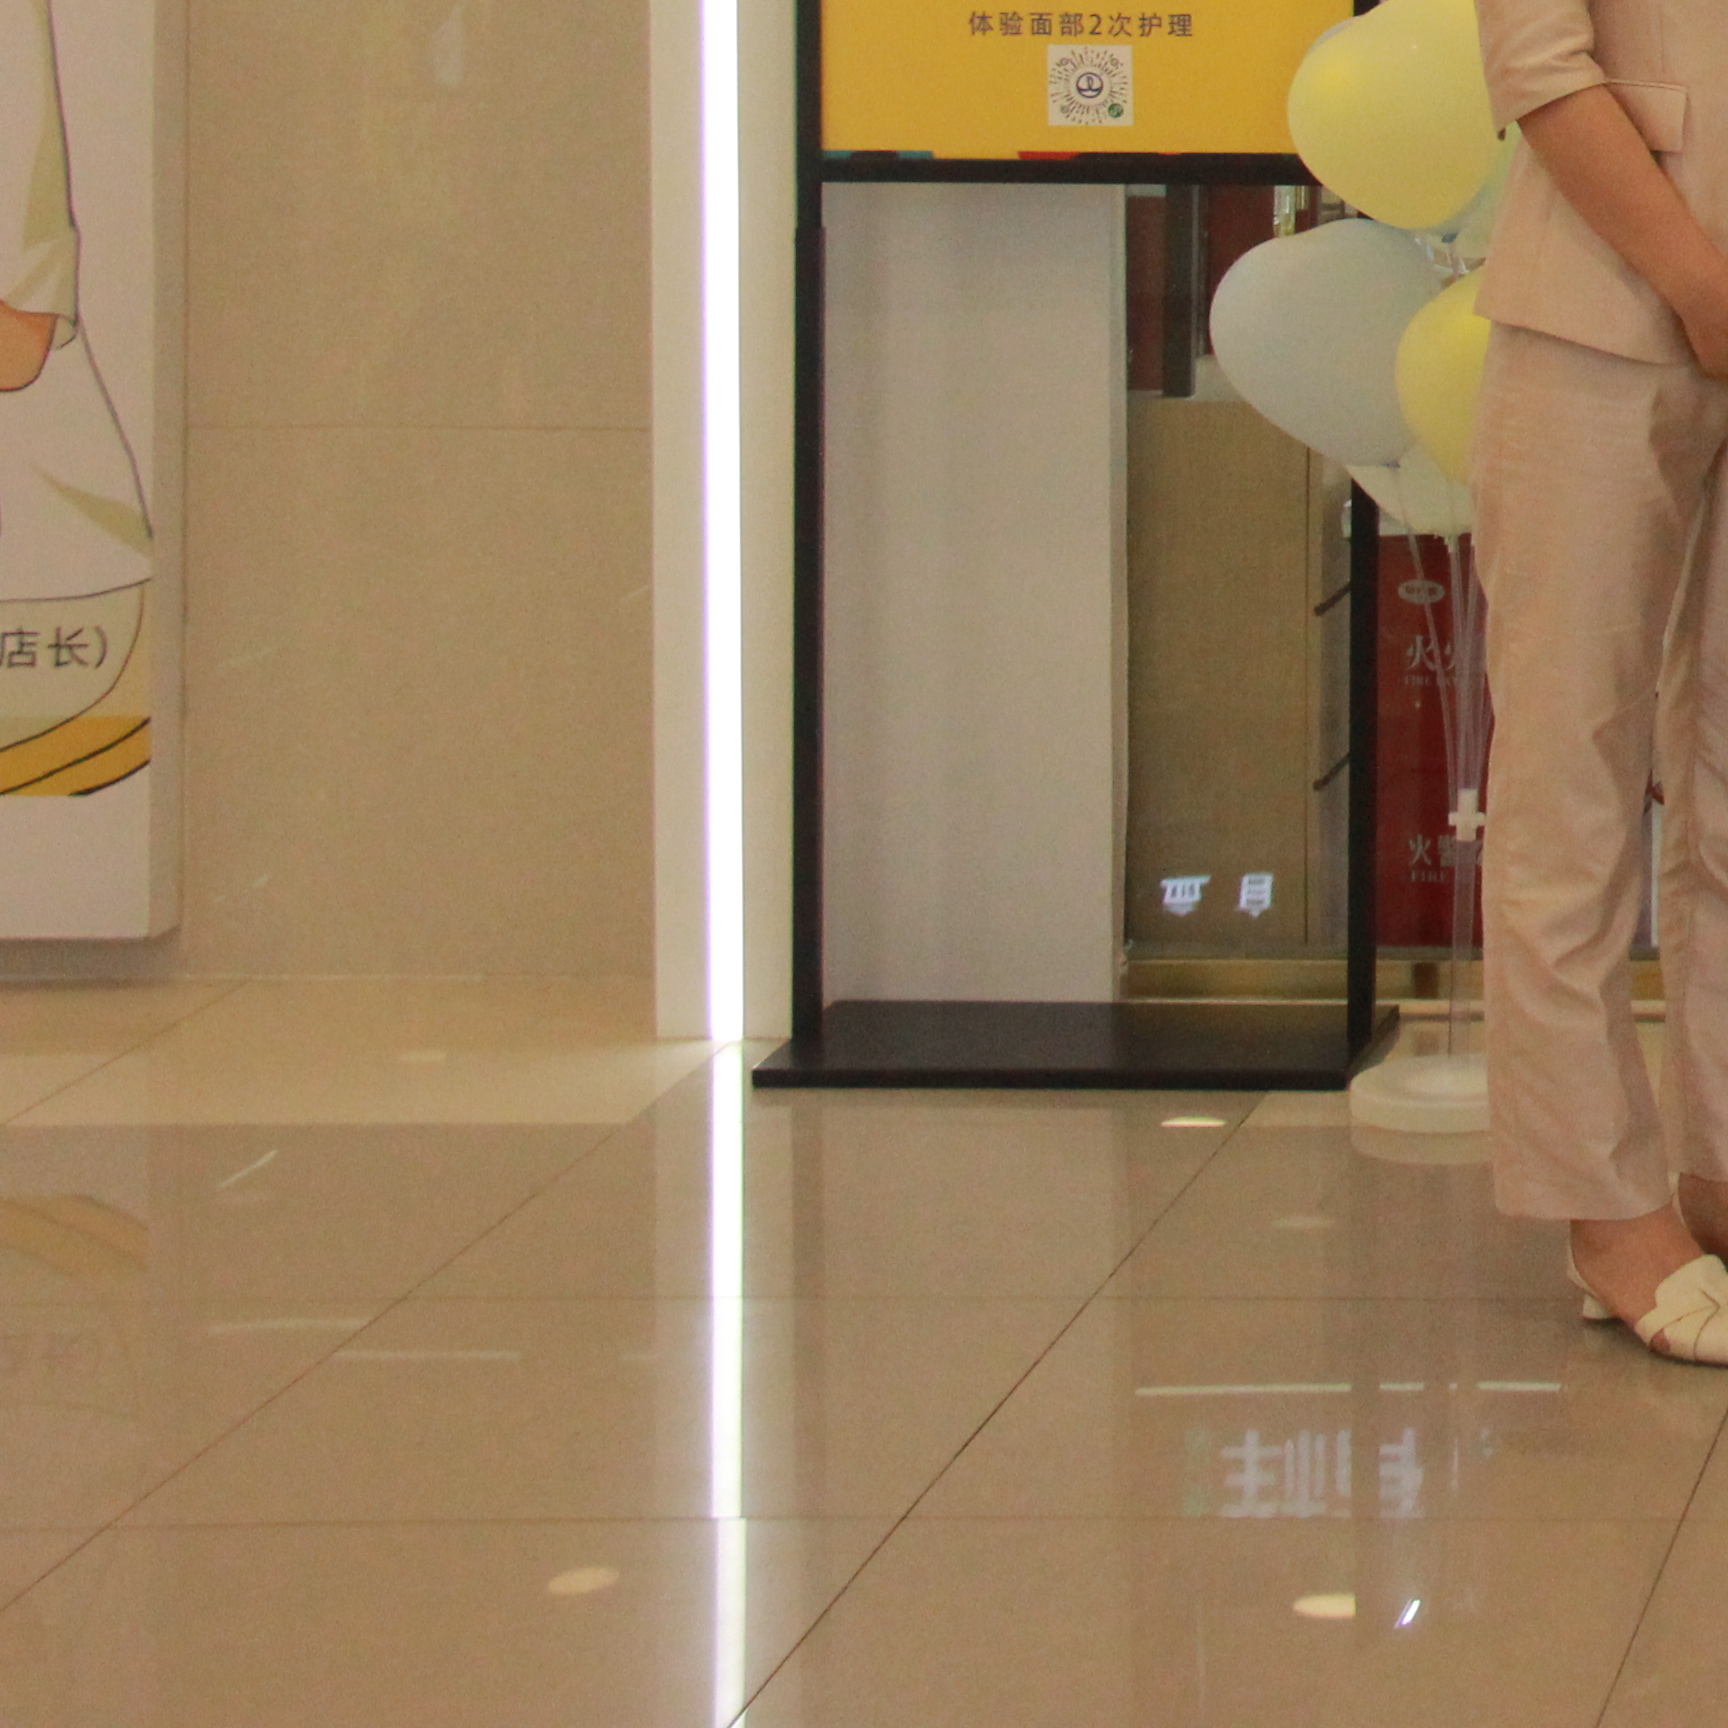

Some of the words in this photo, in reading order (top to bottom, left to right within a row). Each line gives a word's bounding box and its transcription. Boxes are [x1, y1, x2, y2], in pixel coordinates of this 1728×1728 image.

[968, 11, 1195, 39] 体验面部2次护理
